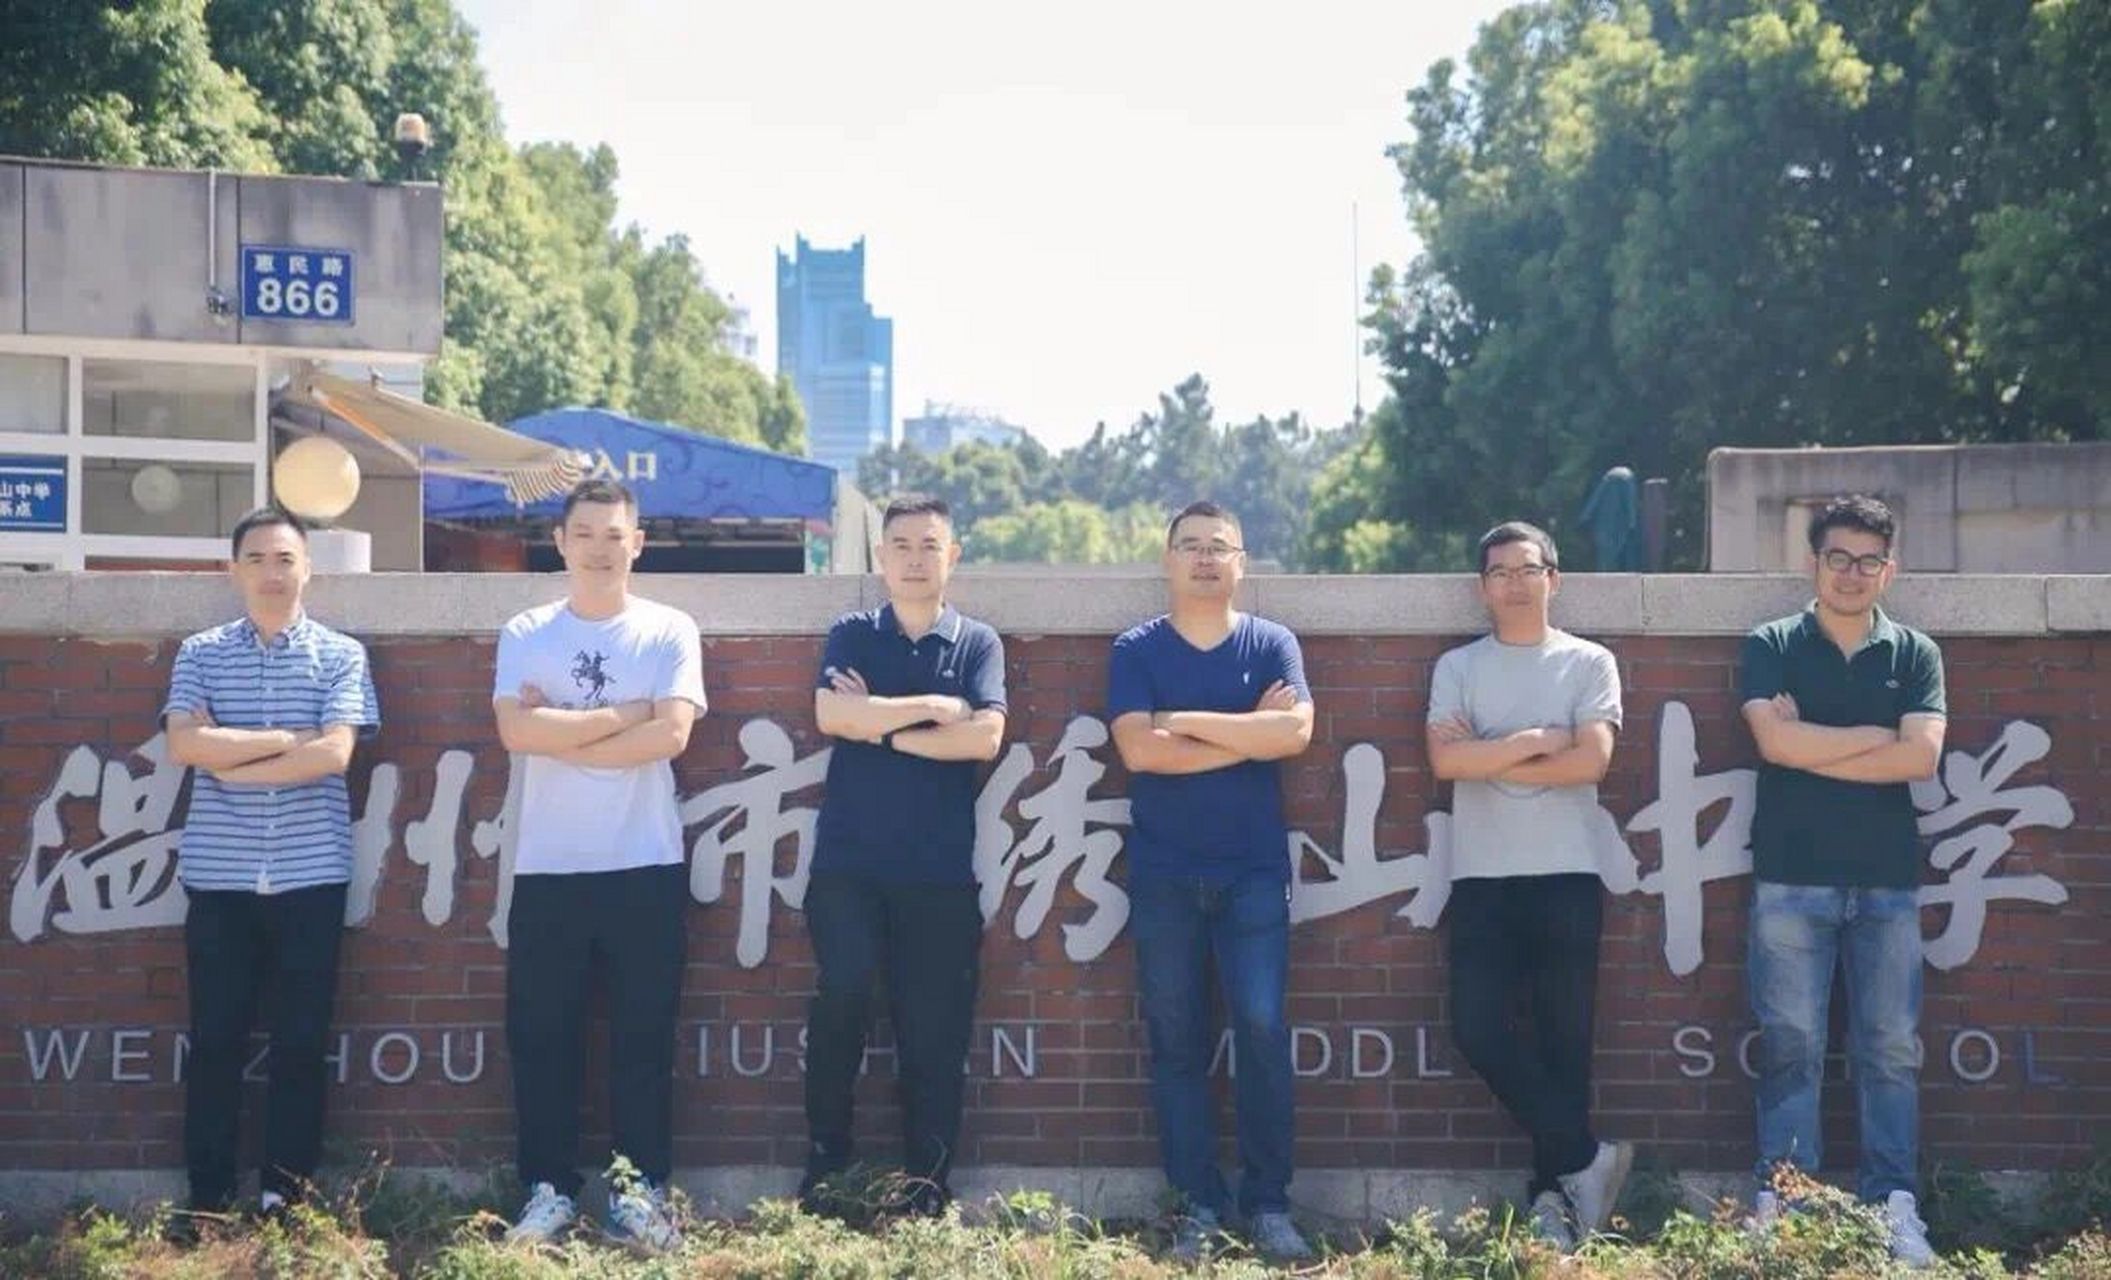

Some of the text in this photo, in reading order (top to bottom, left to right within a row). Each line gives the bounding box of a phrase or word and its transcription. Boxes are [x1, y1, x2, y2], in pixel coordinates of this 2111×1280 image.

[254, 253, 343, 277] 惠民路
[256, 277, 340, 317] 866
